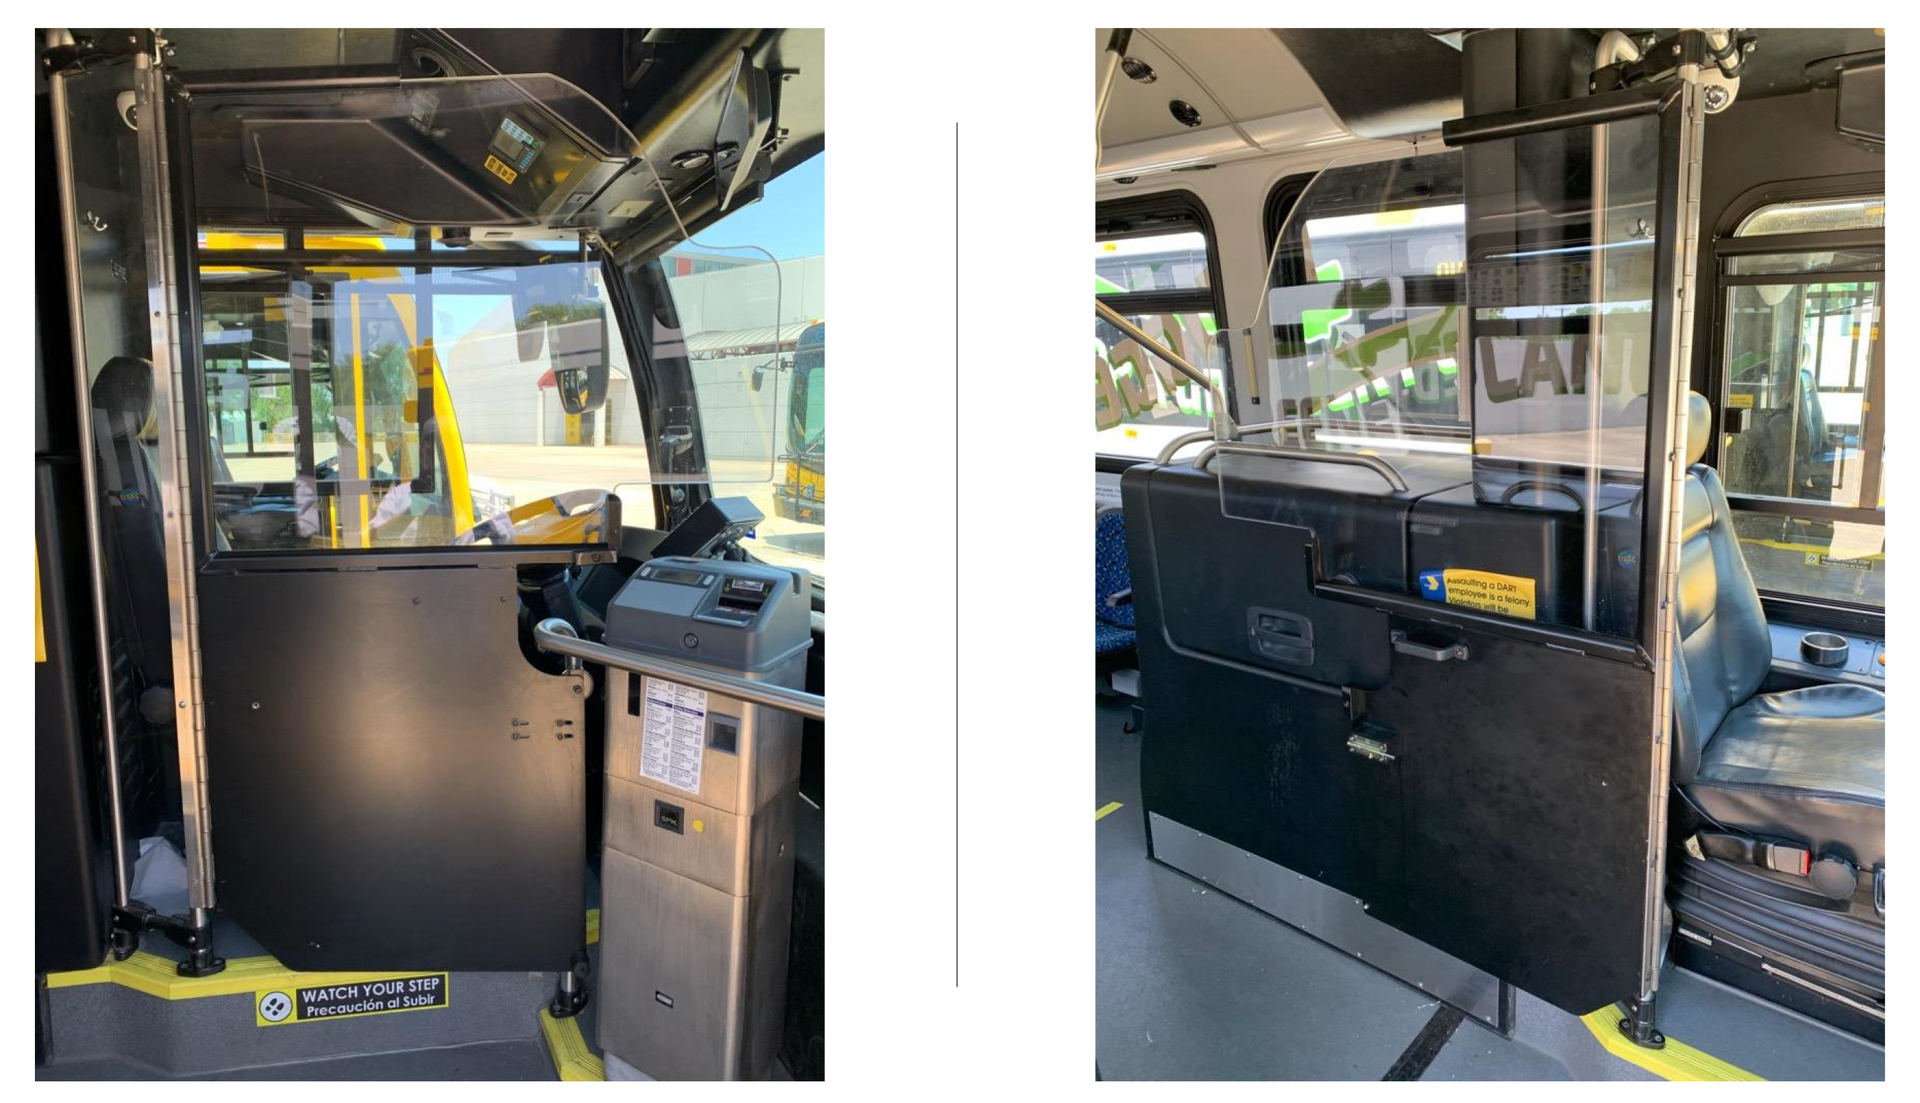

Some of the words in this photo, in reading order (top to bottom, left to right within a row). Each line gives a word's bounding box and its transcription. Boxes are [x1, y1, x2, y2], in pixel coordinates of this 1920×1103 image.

[1447, 578, 1487, 589] Assaulting
[1497, 582, 1517, 593] DART
[1448, 587, 1487, 598] employee
[1489, 592, 1495, 600] is
[1484, 604, 1496, 612] will
[1498, 605, 1509, 613] be
[302, 986, 358, 1003] WATCH
[363, 981, 404, 997] YOUR
[409, 977, 440, 992] STEP
[306, 999, 384, 1017] Precaución
[387, 996, 400, 1008] al
[403, 994, 436, 1006] Subir
